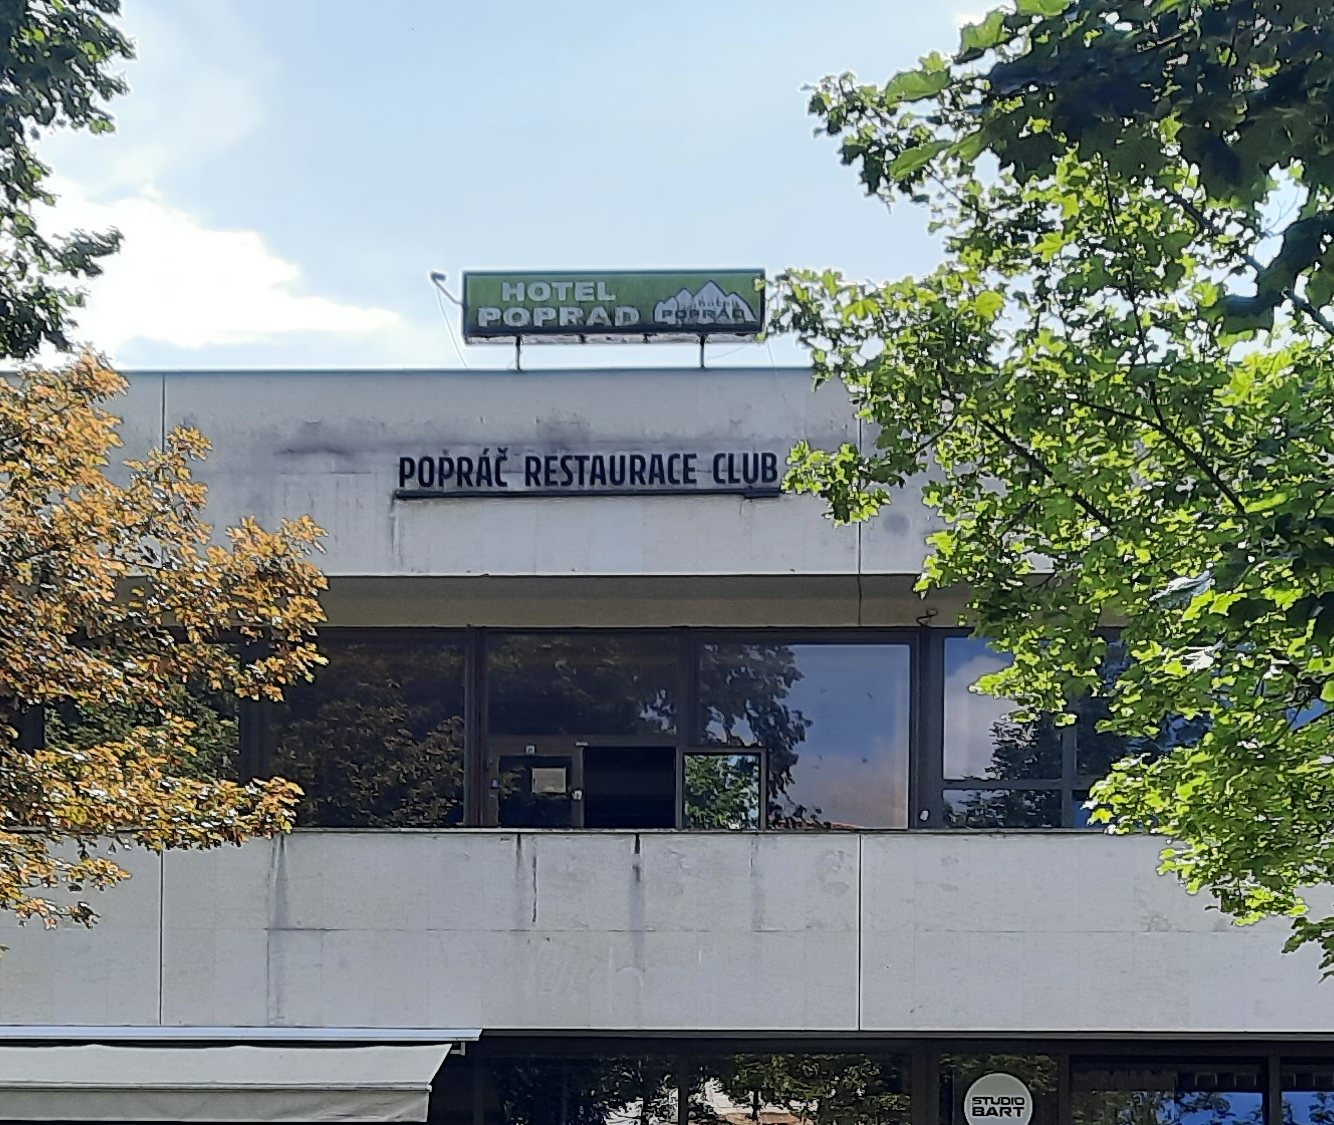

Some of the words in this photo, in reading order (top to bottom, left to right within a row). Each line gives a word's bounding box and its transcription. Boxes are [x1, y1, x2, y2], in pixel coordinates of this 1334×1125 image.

[502, 282, 616, 301] HOTEL
[478, 306, 640, 327] POPRAD
[399, 448, 508, 488] POPRÁČ
[525, 453, 698, 487] RESTAURACE
[712, 452, 779, 485] CLUB
[972, 1096, 1025, 1105] STUDIO
[972, 1107, 1025, 1117] BART
